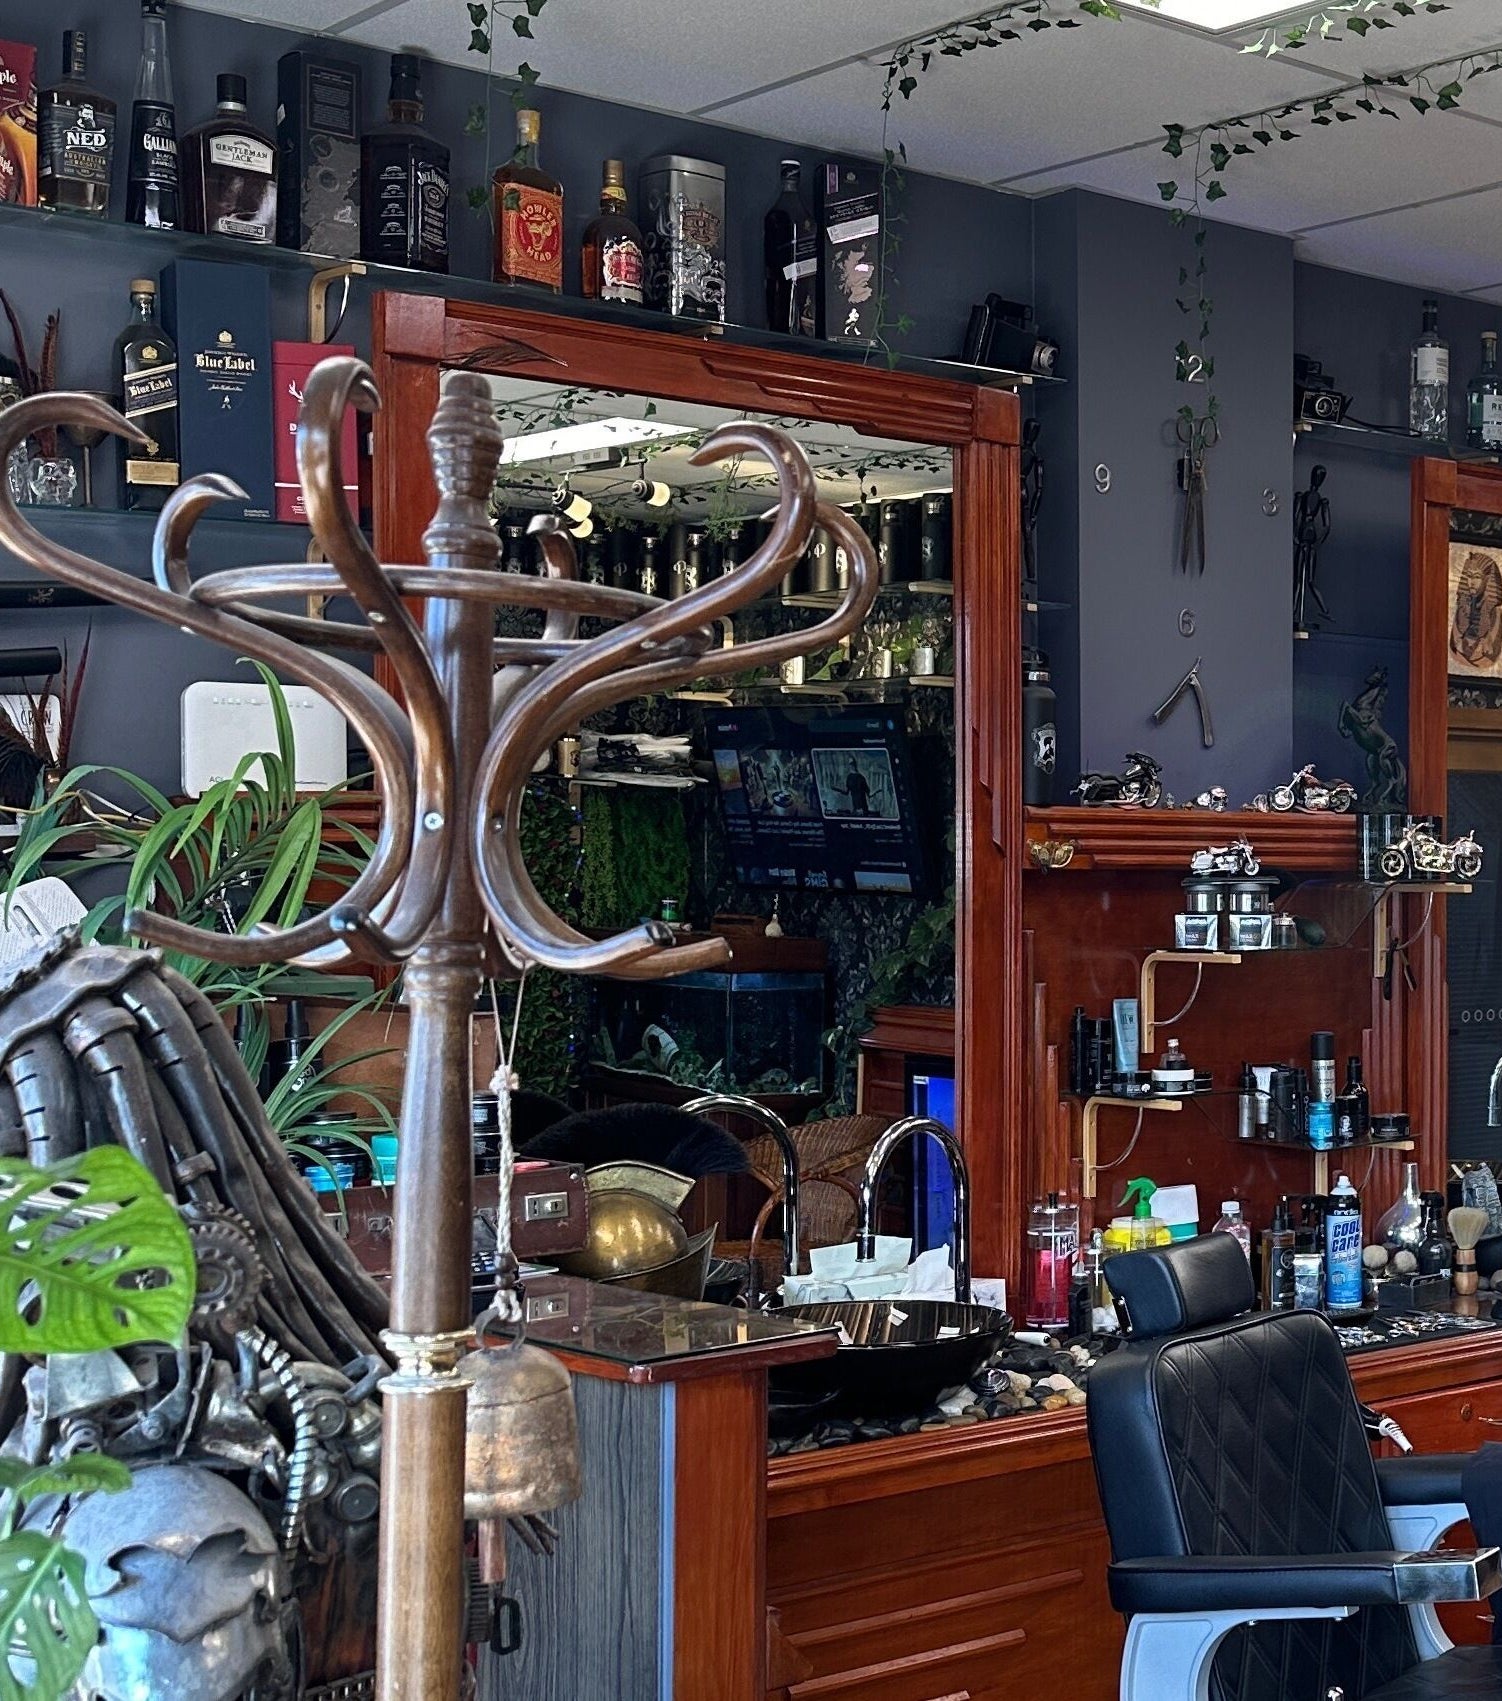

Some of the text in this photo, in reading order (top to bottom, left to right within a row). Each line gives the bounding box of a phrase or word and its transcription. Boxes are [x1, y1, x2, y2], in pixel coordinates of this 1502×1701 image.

[66, 131, 107, 147] NED
[215, 143, 268, 159] GENTLEMAN
[231, 152, 253, 163] JACK
[520, 203, 557, 227] HOWLER
[526, 245, 552, 262] HEAD
[193, 352, 223, 368] Blue
[222, 355, 256, 371] Label
[1094, 463, 1112, 495] 9
[1260, 488, 1280, 517] 3
[1177, 607, 1196, 638] 6
